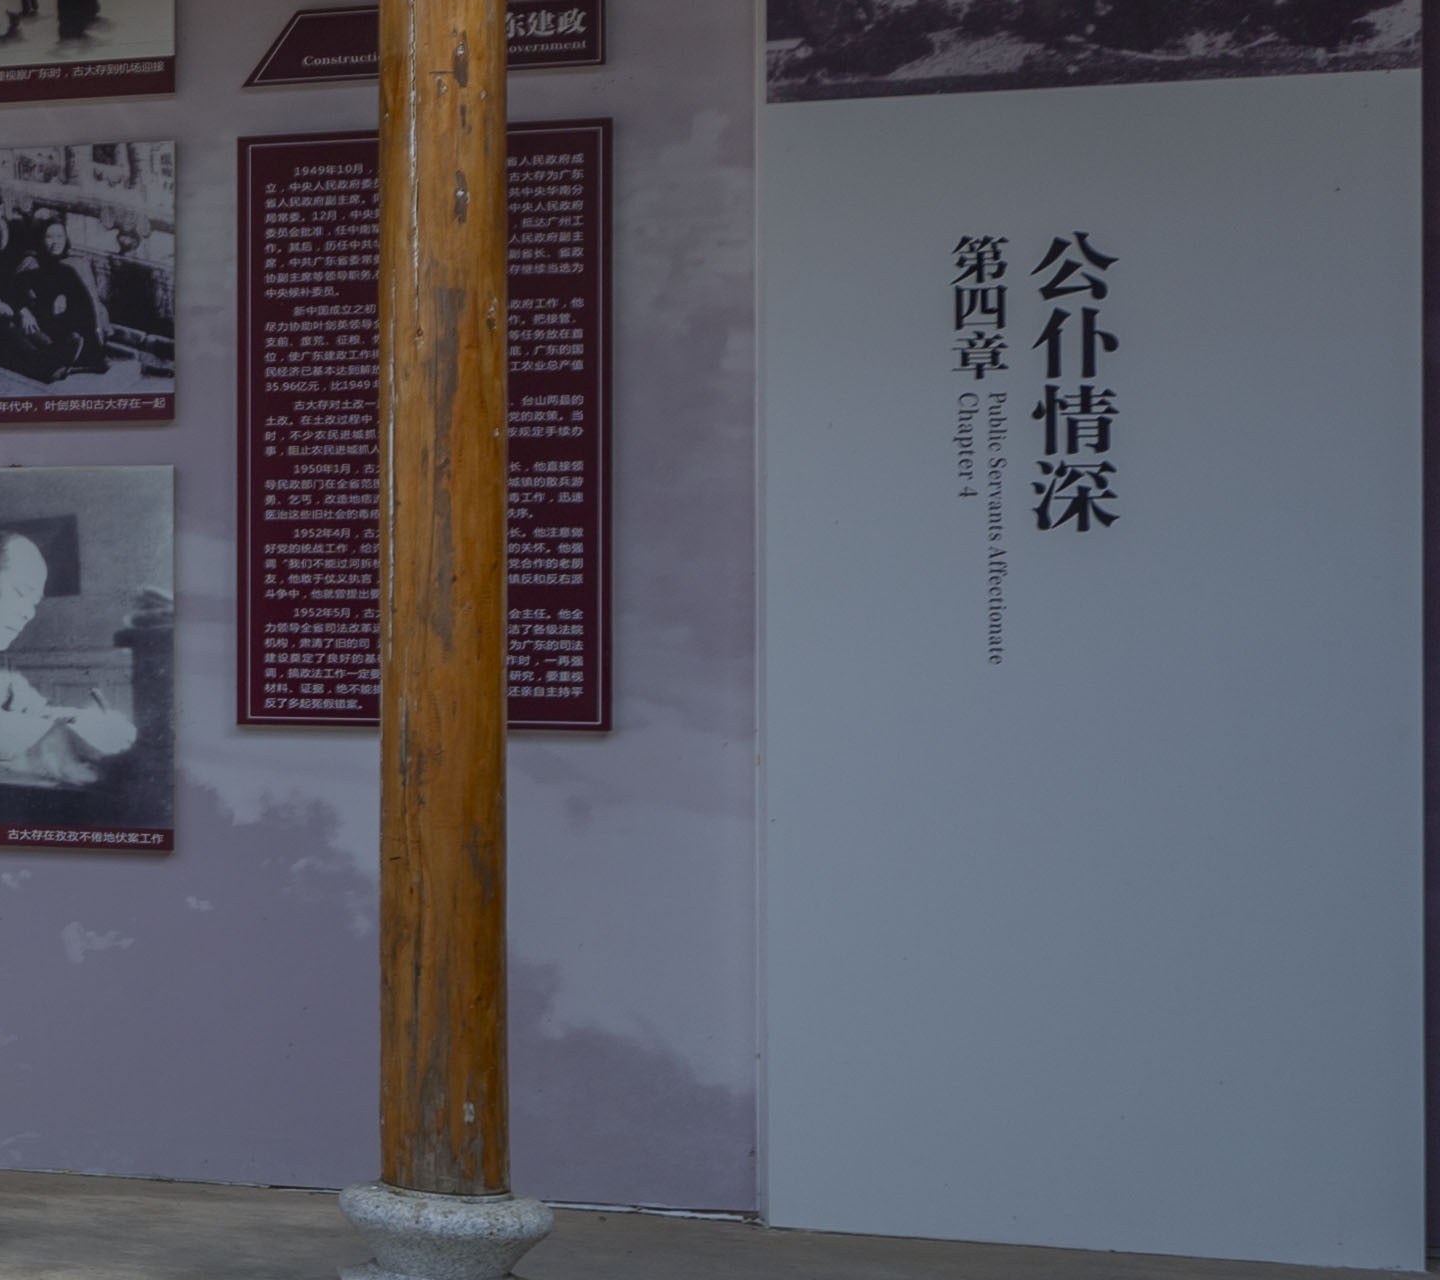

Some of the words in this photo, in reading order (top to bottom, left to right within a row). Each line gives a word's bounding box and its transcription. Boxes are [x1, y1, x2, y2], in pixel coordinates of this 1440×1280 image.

[506, 38, 587, 55] overnment
[950, 235, 1010, 380] 第四章
[988, 392, 1008, 454] Public
[1029, 230, 1121, 533] 公仆情深
[955, 392, 980, 482] Chapter
[959, 487, 979, 499] 4
[988, 457, 1008, 542] Servants
[988, 547, 1008, 666] Affectionate
